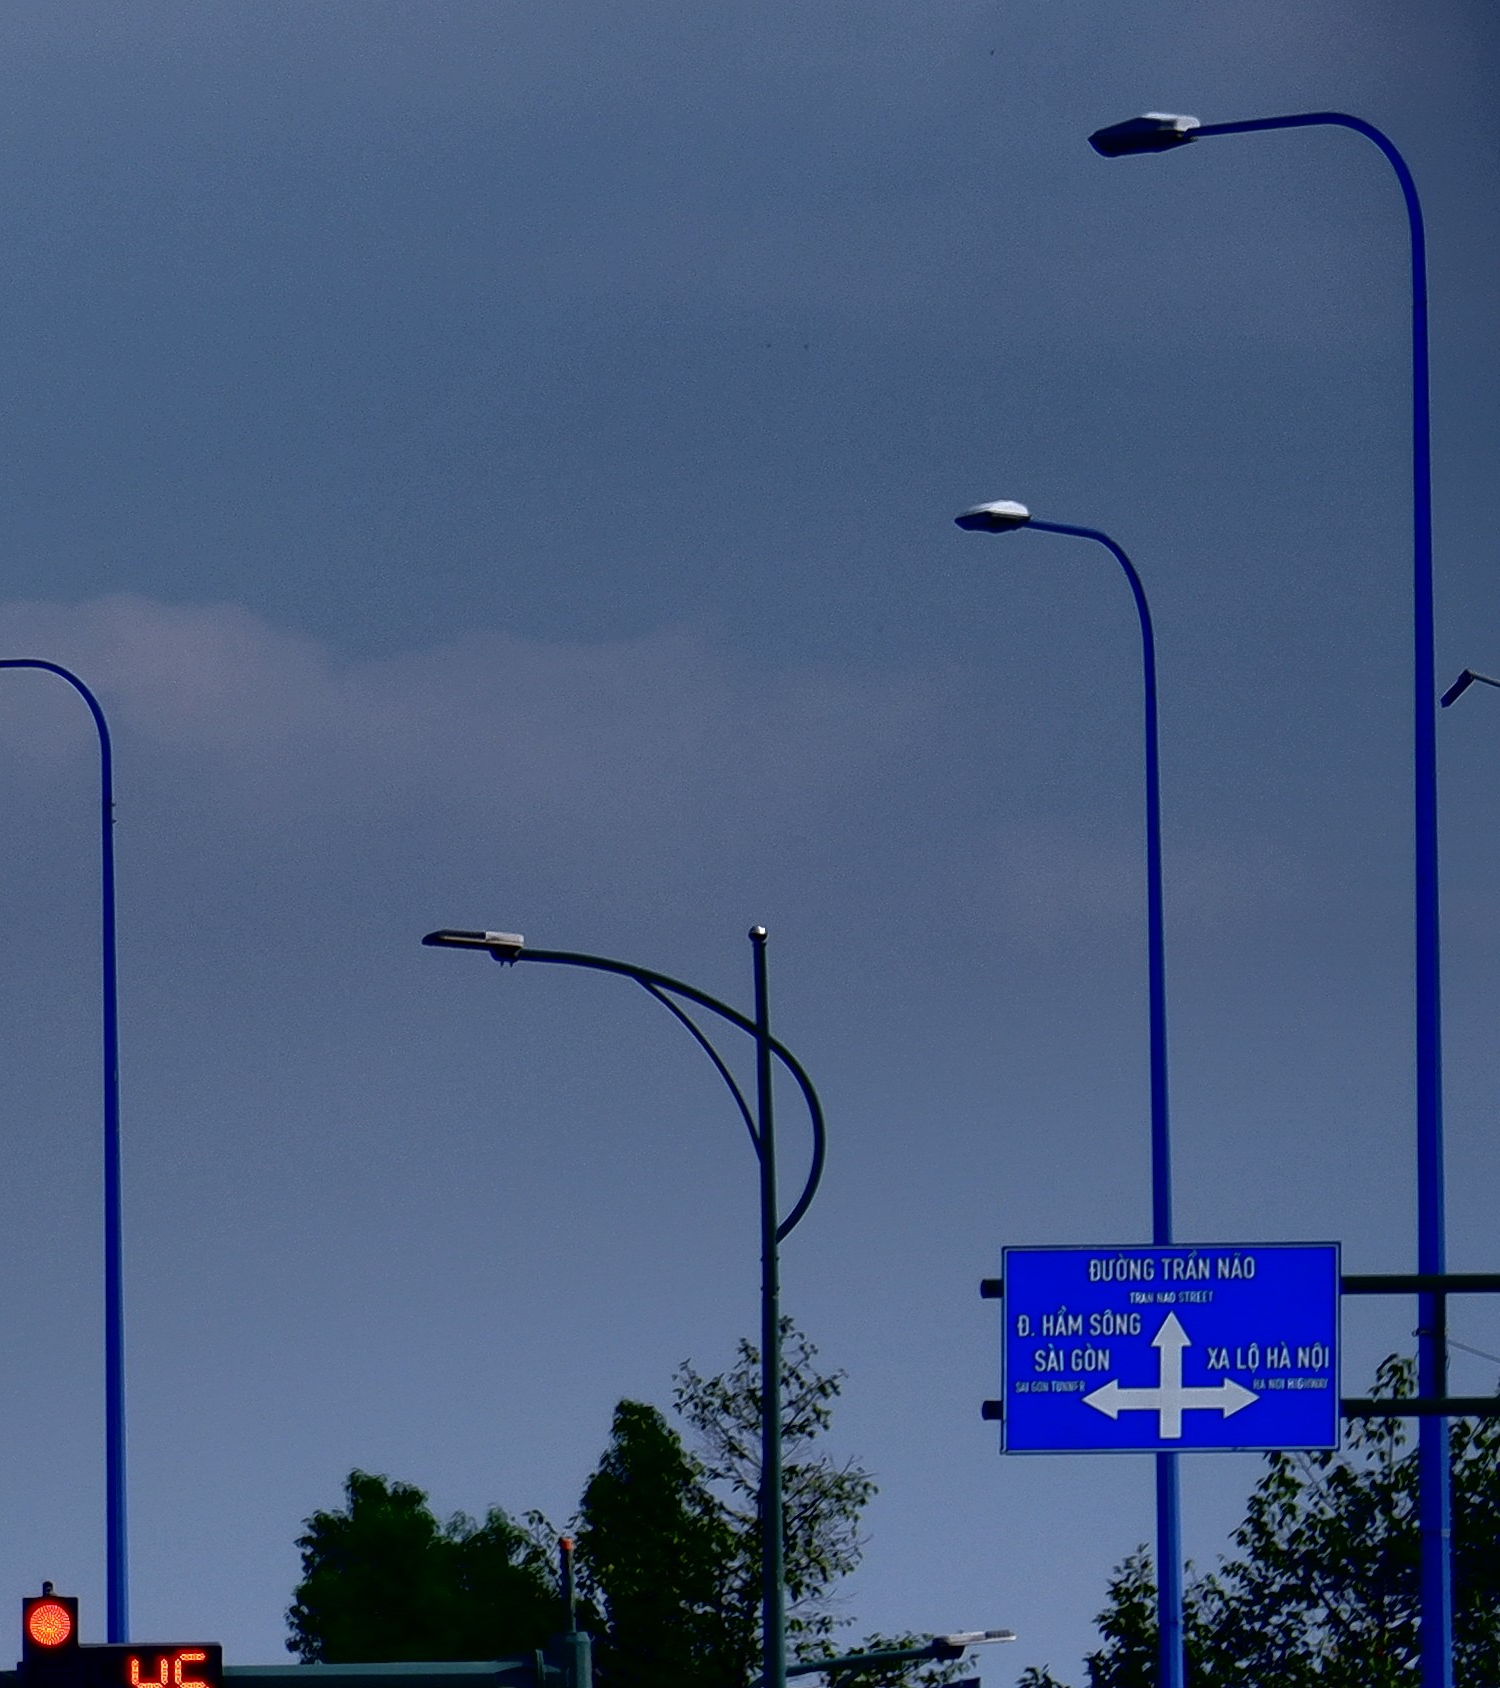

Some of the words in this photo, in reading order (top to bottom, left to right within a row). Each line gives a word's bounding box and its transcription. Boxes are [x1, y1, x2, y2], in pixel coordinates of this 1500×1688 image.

[1088, 1253, 1155, 1282] ĐƯỜNG
[1161, 1250, 1211, 1281] TRẦN
[1217, 1252, 1256, 1280] NÃO
[1129, 1291, 1154, 1304] TRAN
[1178, 1290, 1213, 1304] STREET
[1016, 1314, 1036, 1337] Đ.
[1042, 1305, 1083, 1337] HẦM
[1088, 1308, 1142, 1337] SÔNG
[1034, 1342, 1065, 1373] SÀI
[1070, 1342, 1110, 1372] GÒN
[1206, 1347, 1230, 1371] XA
[1236, 1342, 1260, 1374] LỘ
[1266, 1341, 1290, 1370] HÀ
[1297, 1342, 1329, 1373] NỘI
